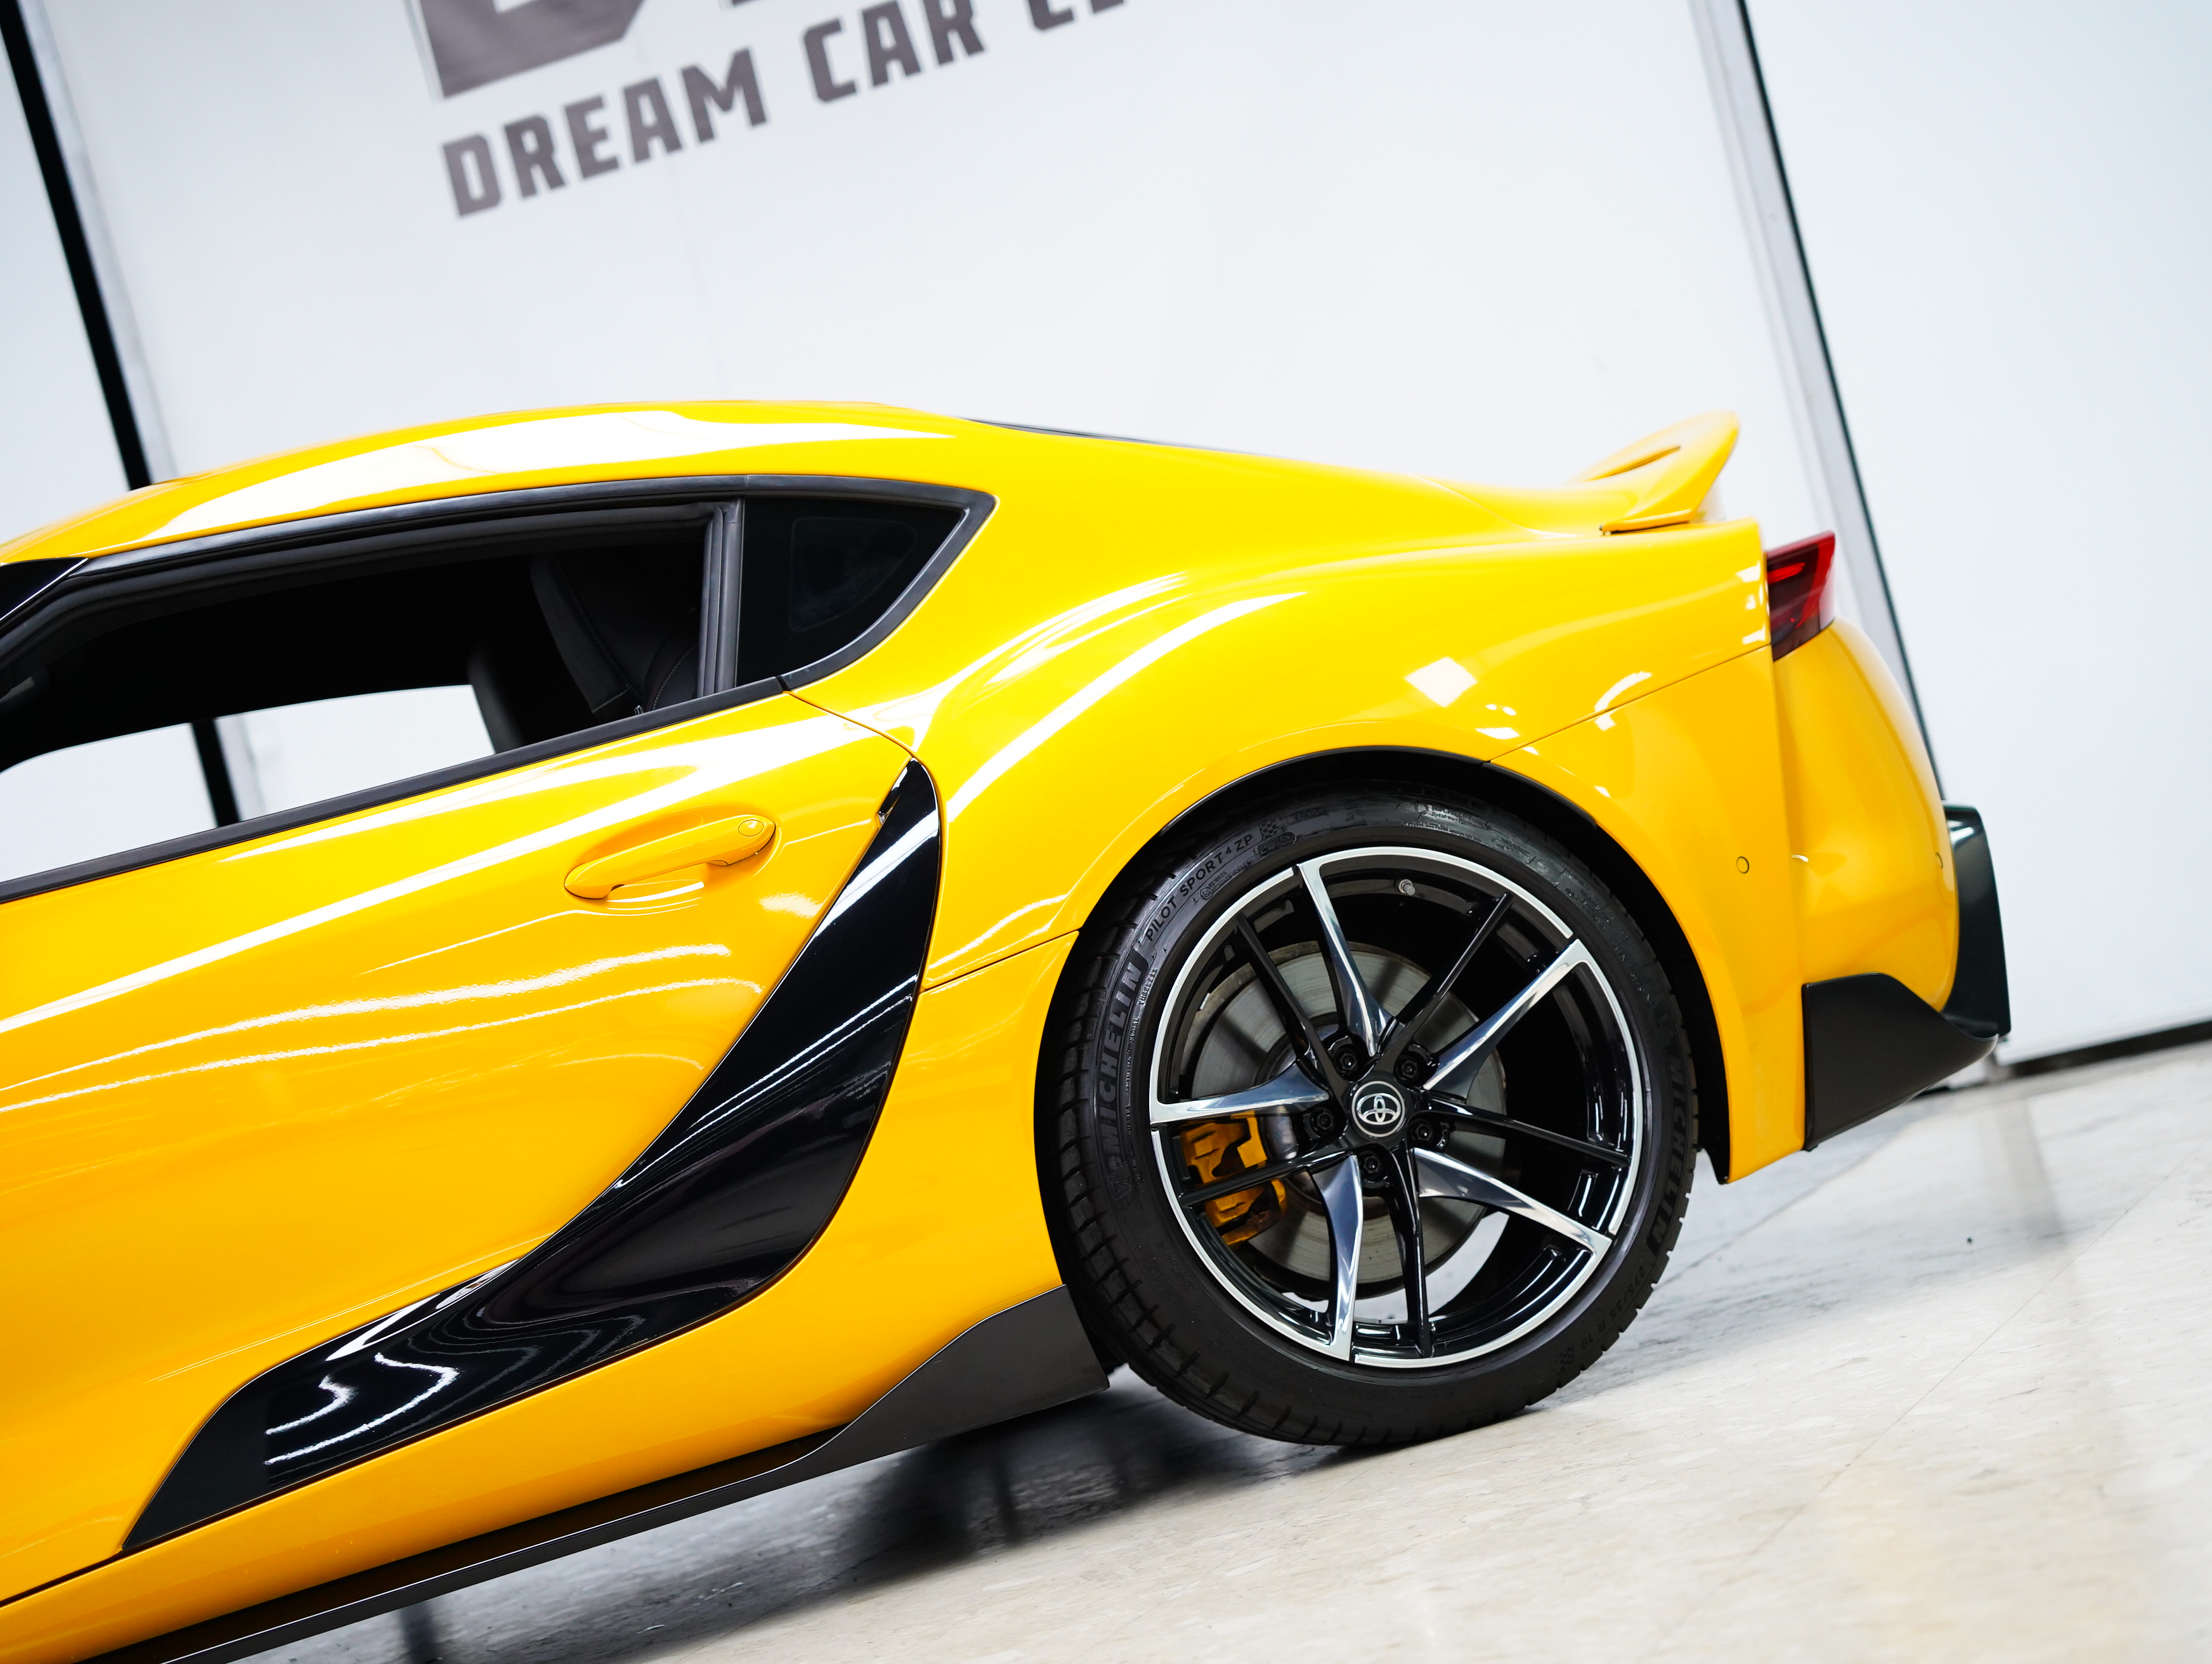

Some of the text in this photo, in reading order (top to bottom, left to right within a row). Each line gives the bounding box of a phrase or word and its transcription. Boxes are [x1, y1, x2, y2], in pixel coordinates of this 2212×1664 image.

[442, 47, 767, 217] DREAM
[802, 0, 986, 103] CAR
[1145, 896, 1178, 941] PILOT
[1180, 852, 1223, 897] SPORT
[1234, 834, 1252, 852] ZP
[1099, 961, 1142, 1154] MICHELIN
[1651, 1056, 1686, 1244] MICHELIN
